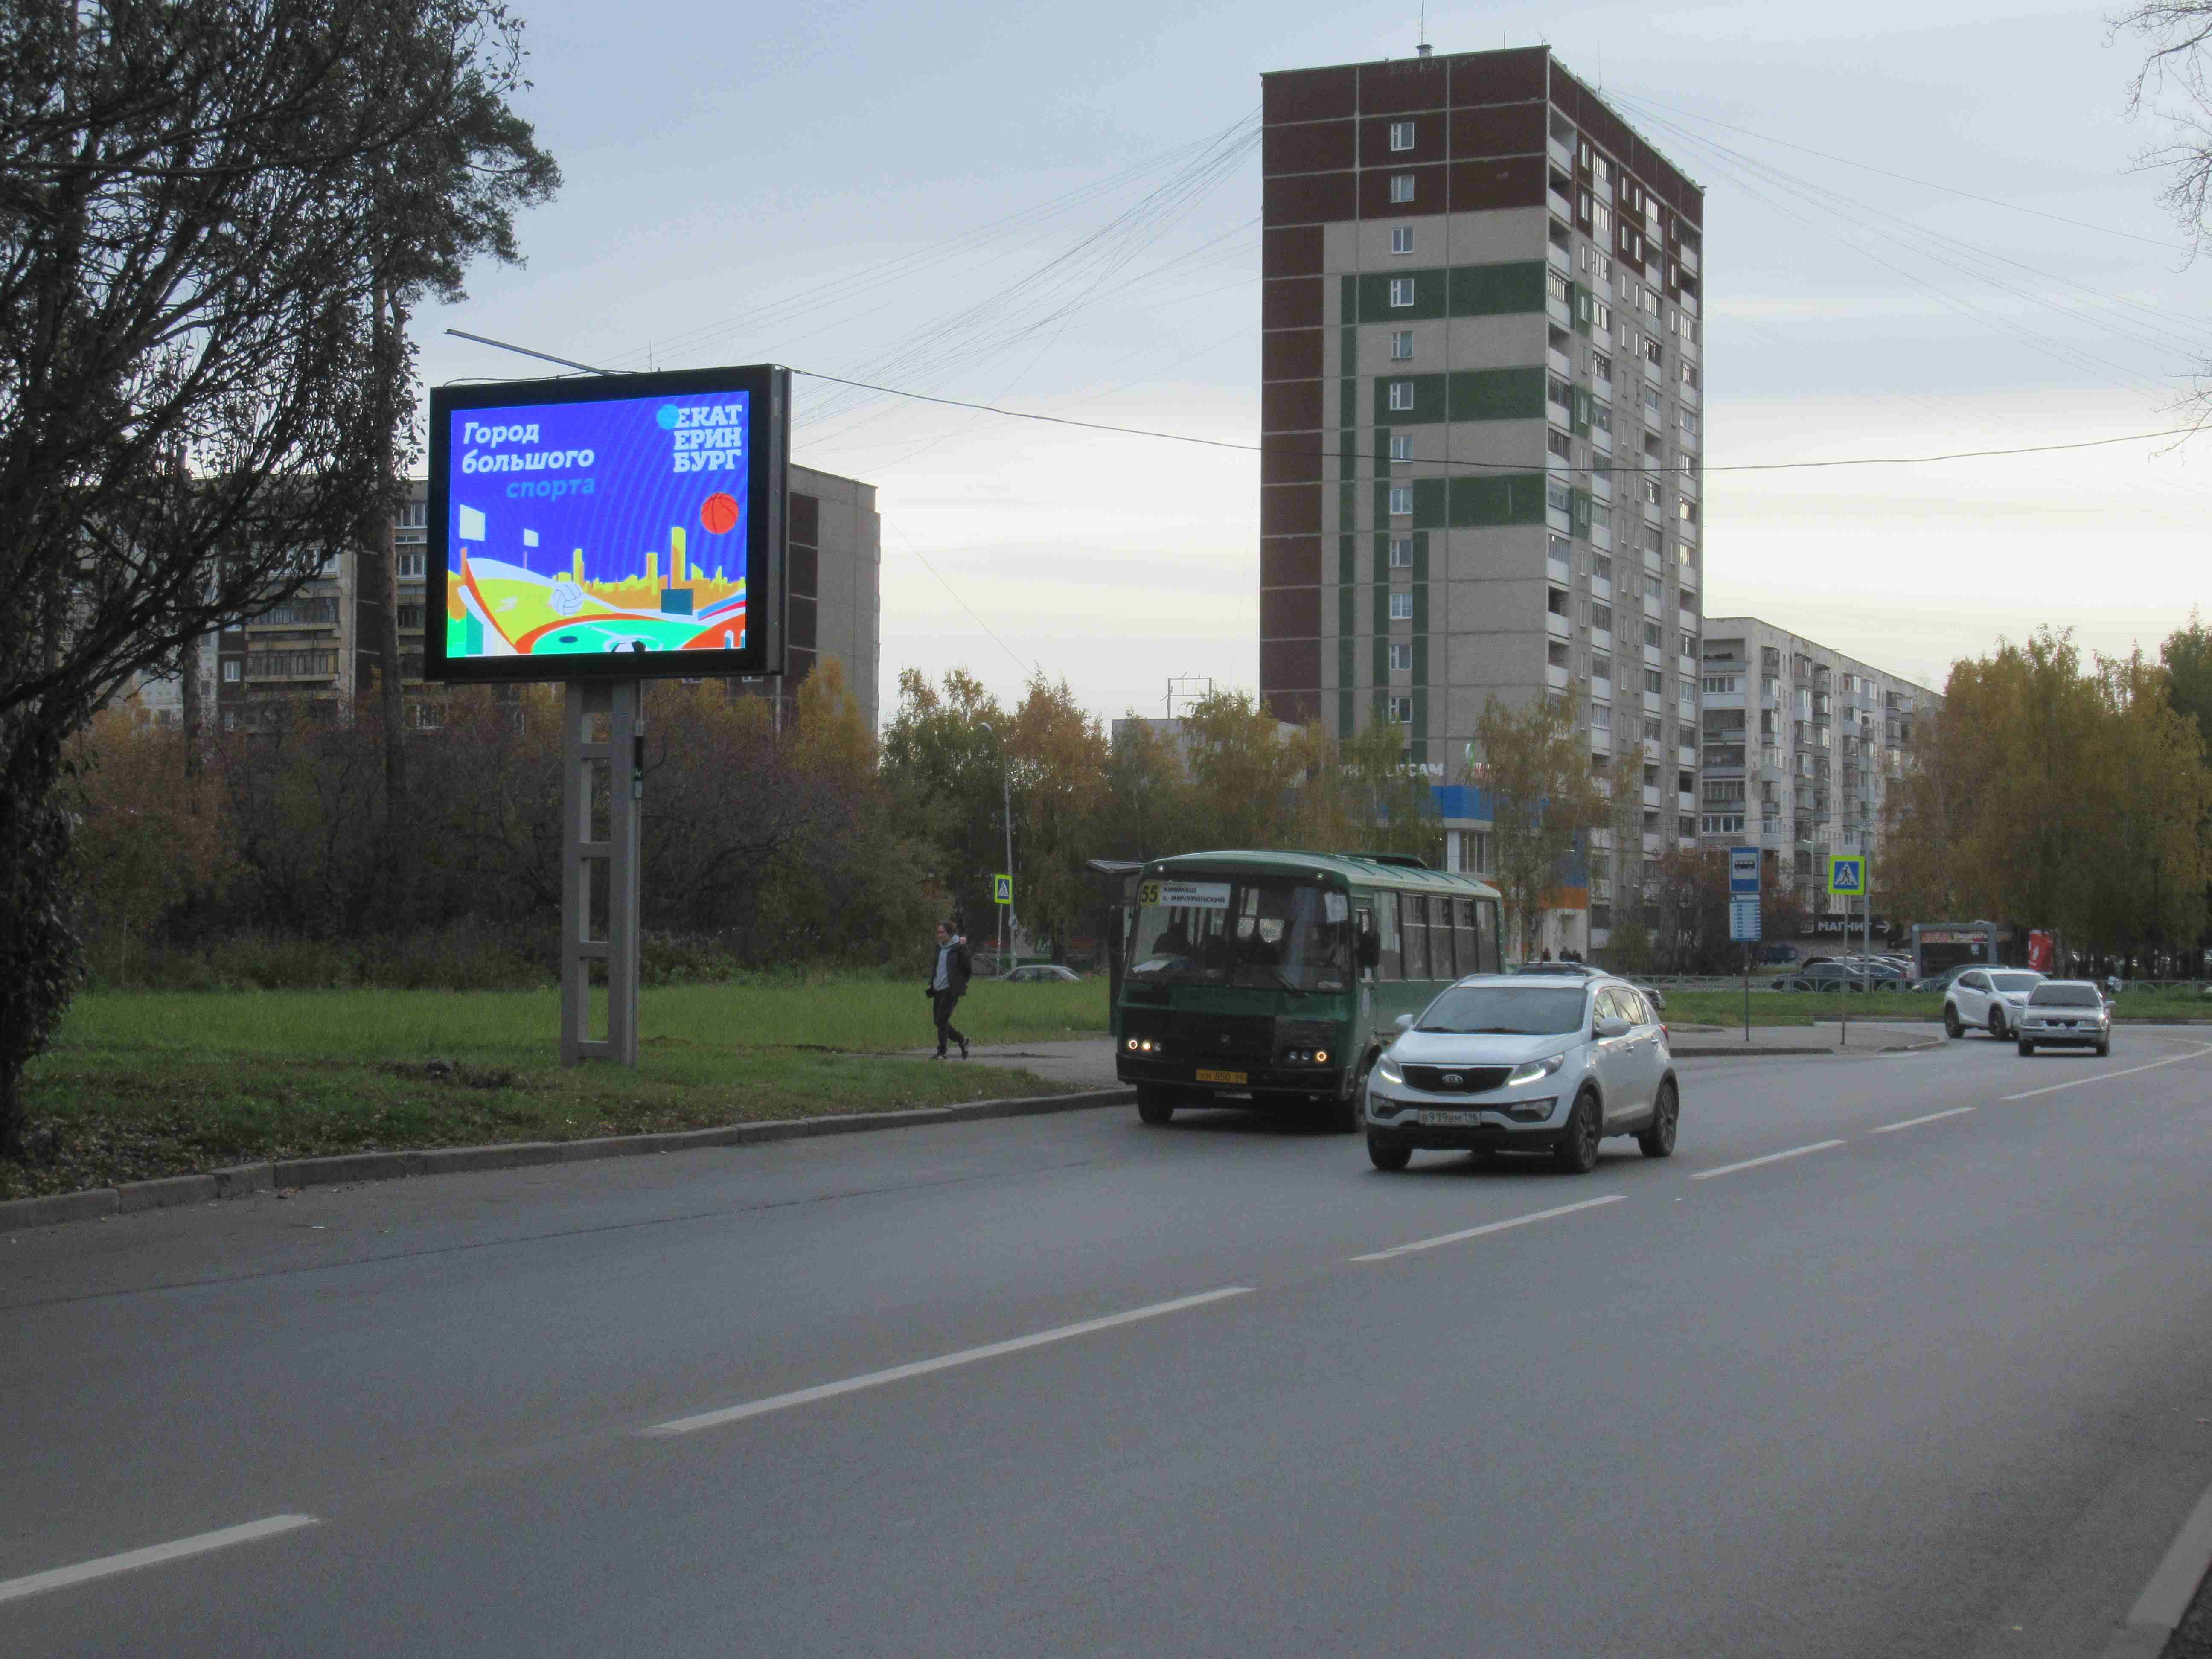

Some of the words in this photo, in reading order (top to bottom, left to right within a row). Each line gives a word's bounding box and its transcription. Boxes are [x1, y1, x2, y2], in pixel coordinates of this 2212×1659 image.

[675, 405, 742, 428] ЕКАТ
[463, 422, 540, 449] Город
[674, 427, 742, 450] ЕРИН
[462, 449, 595, 474] большого
[673, 449, 742, 473] БУРГ
[506, 477, 595, 502] спорта
[1141, 885, 1158, 903] 55
[1170, 895, 1225, 904] МИЧУРИНСКИЙ
